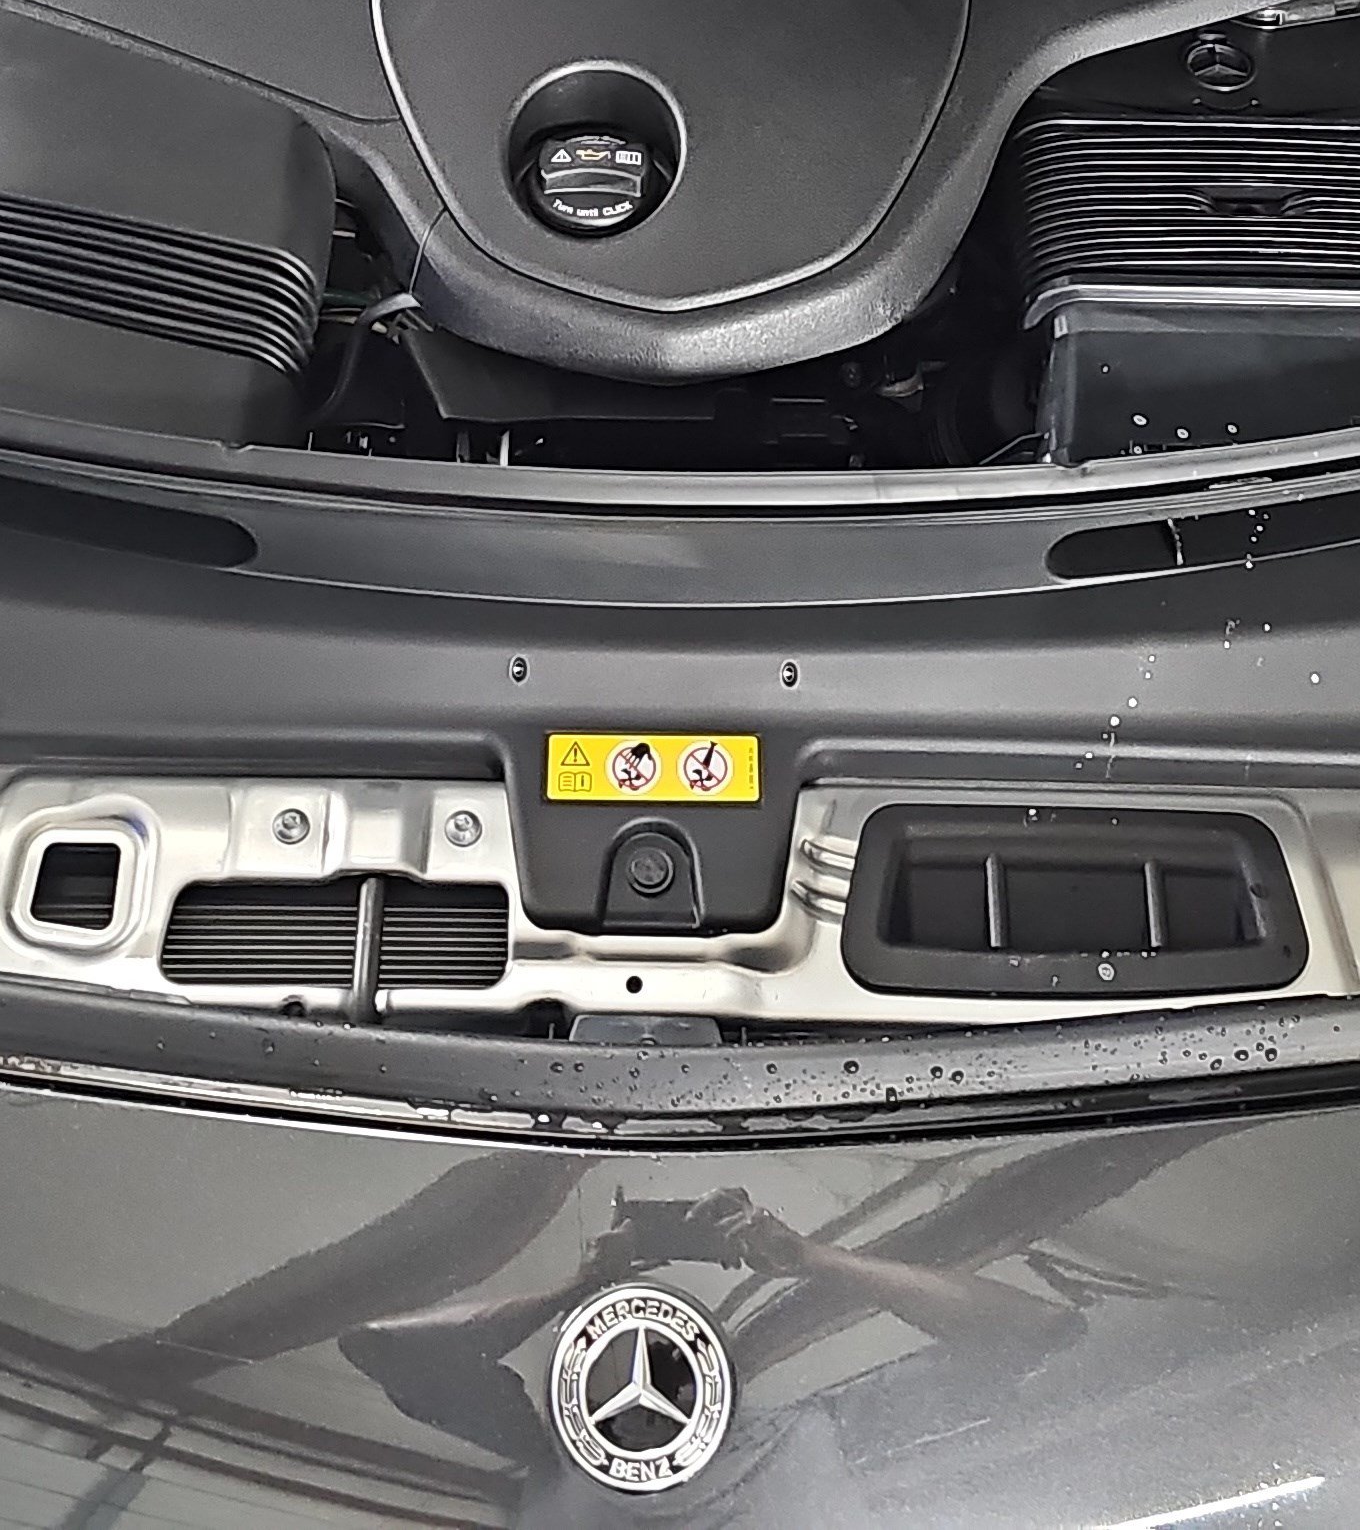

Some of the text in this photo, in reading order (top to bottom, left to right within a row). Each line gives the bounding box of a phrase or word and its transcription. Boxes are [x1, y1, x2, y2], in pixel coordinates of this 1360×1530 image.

[553, 197, 634, 217] Turn until CLICK
[585, 1298, 701, 1342] MERCEDES
[608, 1456, 674, 1482] BENZ
